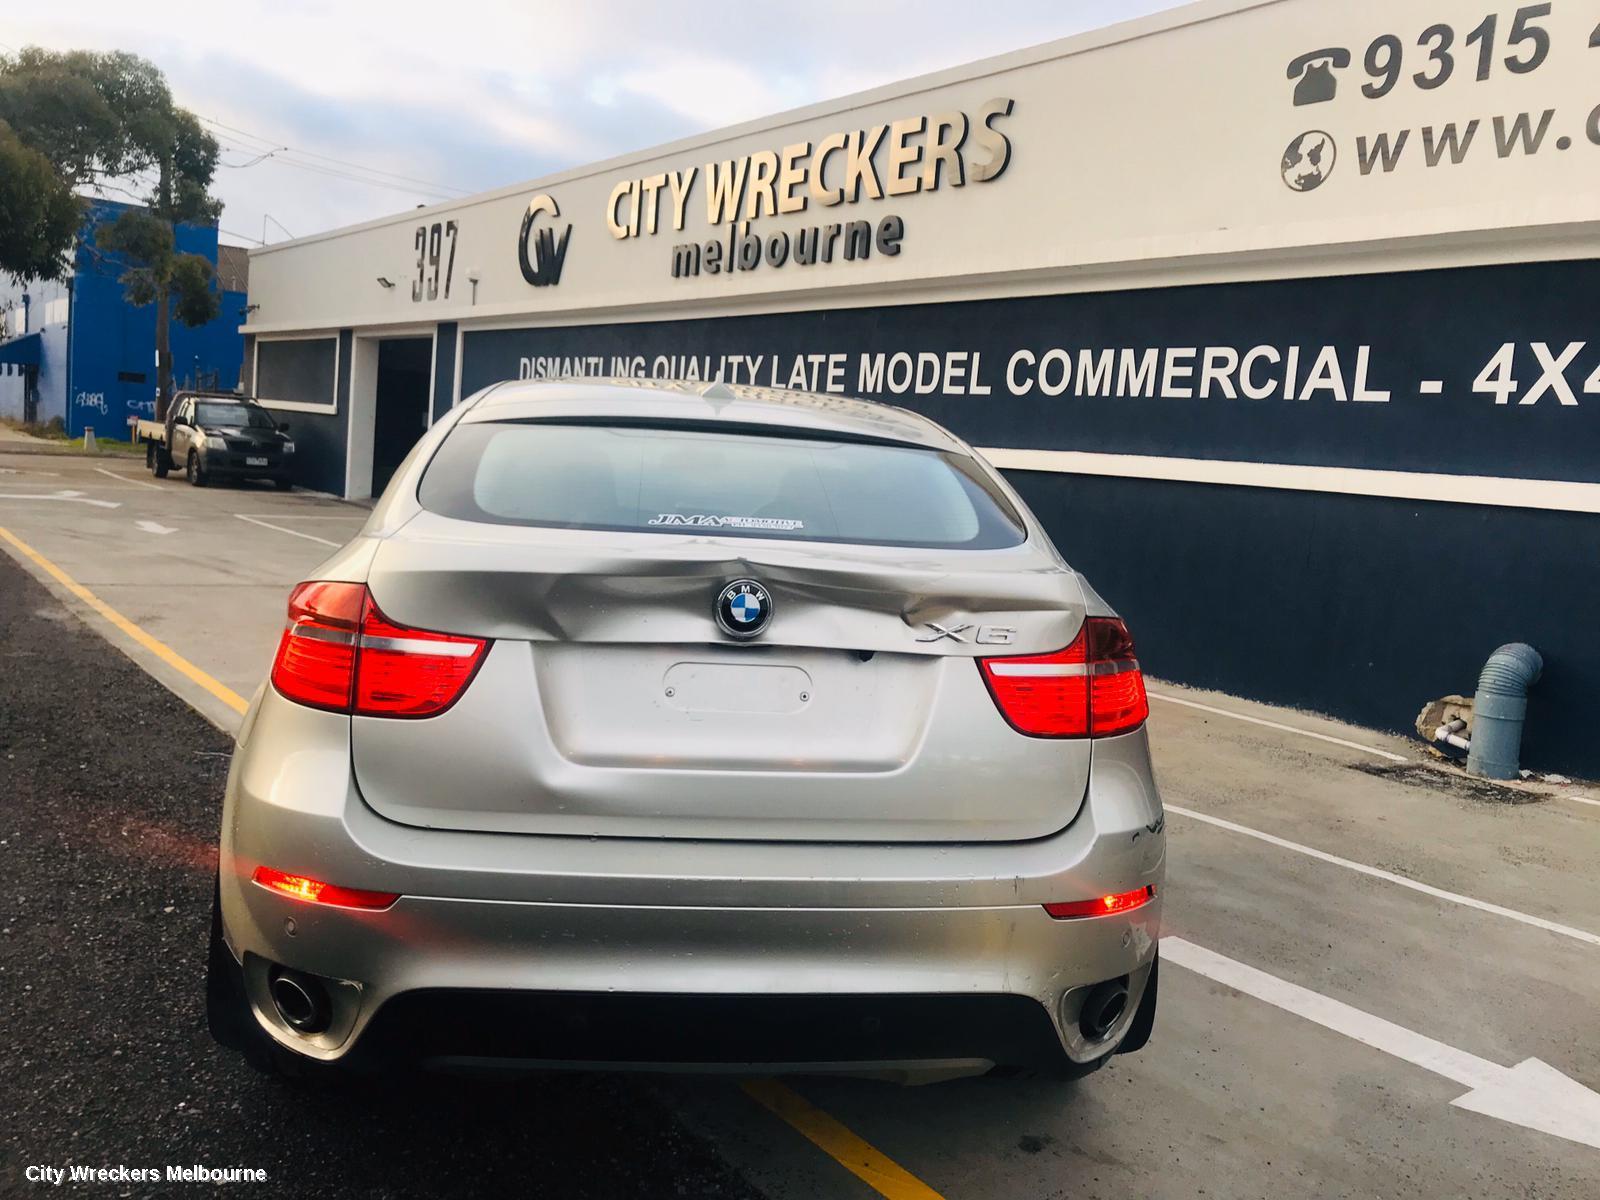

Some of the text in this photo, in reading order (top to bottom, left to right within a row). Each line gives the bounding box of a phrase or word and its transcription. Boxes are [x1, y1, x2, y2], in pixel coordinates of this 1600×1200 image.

[1361, 2, 1551, 99] 9315
[606, 96, 1015, 240] CITY WRECKERS
[412, 219, 459, 303] 397
[671, 214, 905, 278] melbourne
[652, 355, 764, 386] QUALITY
[770, 353, 848, 393] LATE
[857, 351, 992, 395] MODEL
[1006, 344, 1392, 402] COMMERCIAL
[726, 585, 765, 601] BMW
[915, 623, 1017, 645] X6
